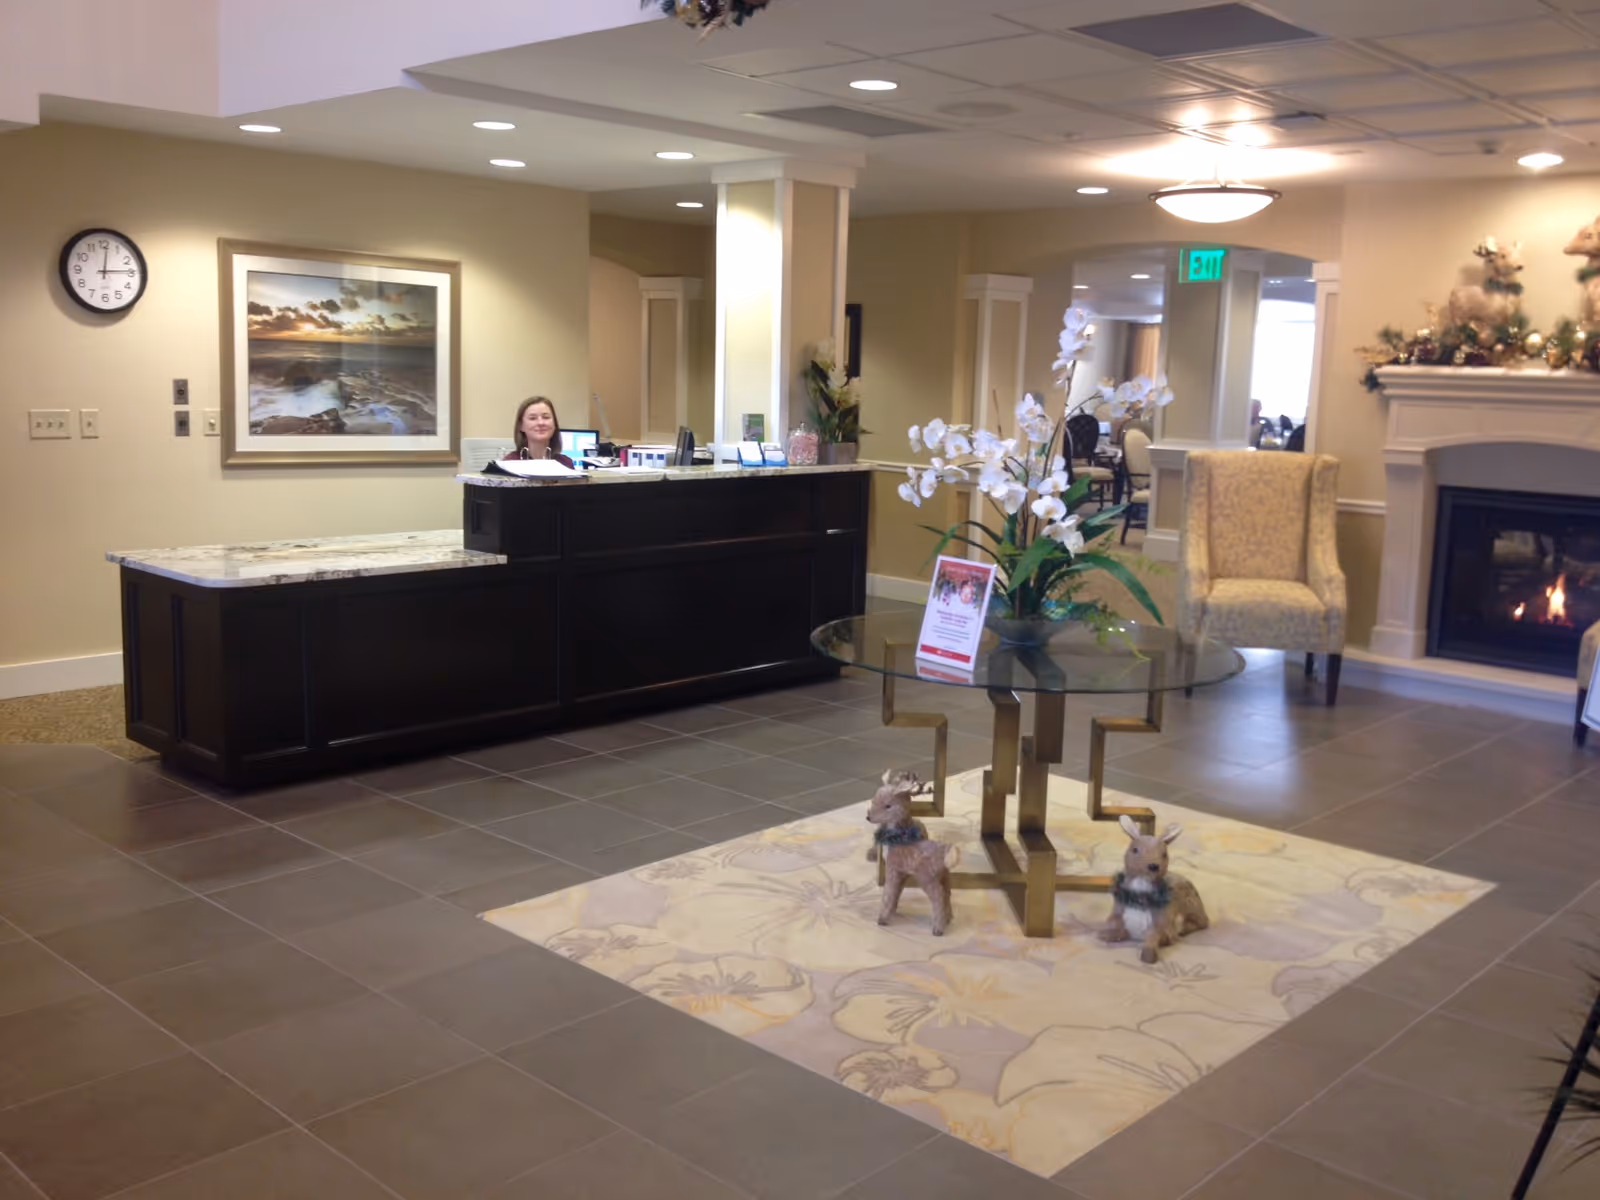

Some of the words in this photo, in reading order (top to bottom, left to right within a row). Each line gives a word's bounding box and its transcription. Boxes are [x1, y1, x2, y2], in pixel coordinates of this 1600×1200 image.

[88, 244, 95, 252] 11
[98, 240, 109, 249] 12
[77, 253, 88, 262] 10
[123, 256, 131, 265] 2
[1188, 249, 1225, 280] EXIT
[74, 265, 82, 274] 9
[78, 279, 85, 287] 8
[88, 289, 95, 298] 7
[101, 294, 109, 302] 6
[115, 291, 122, 299] 5
